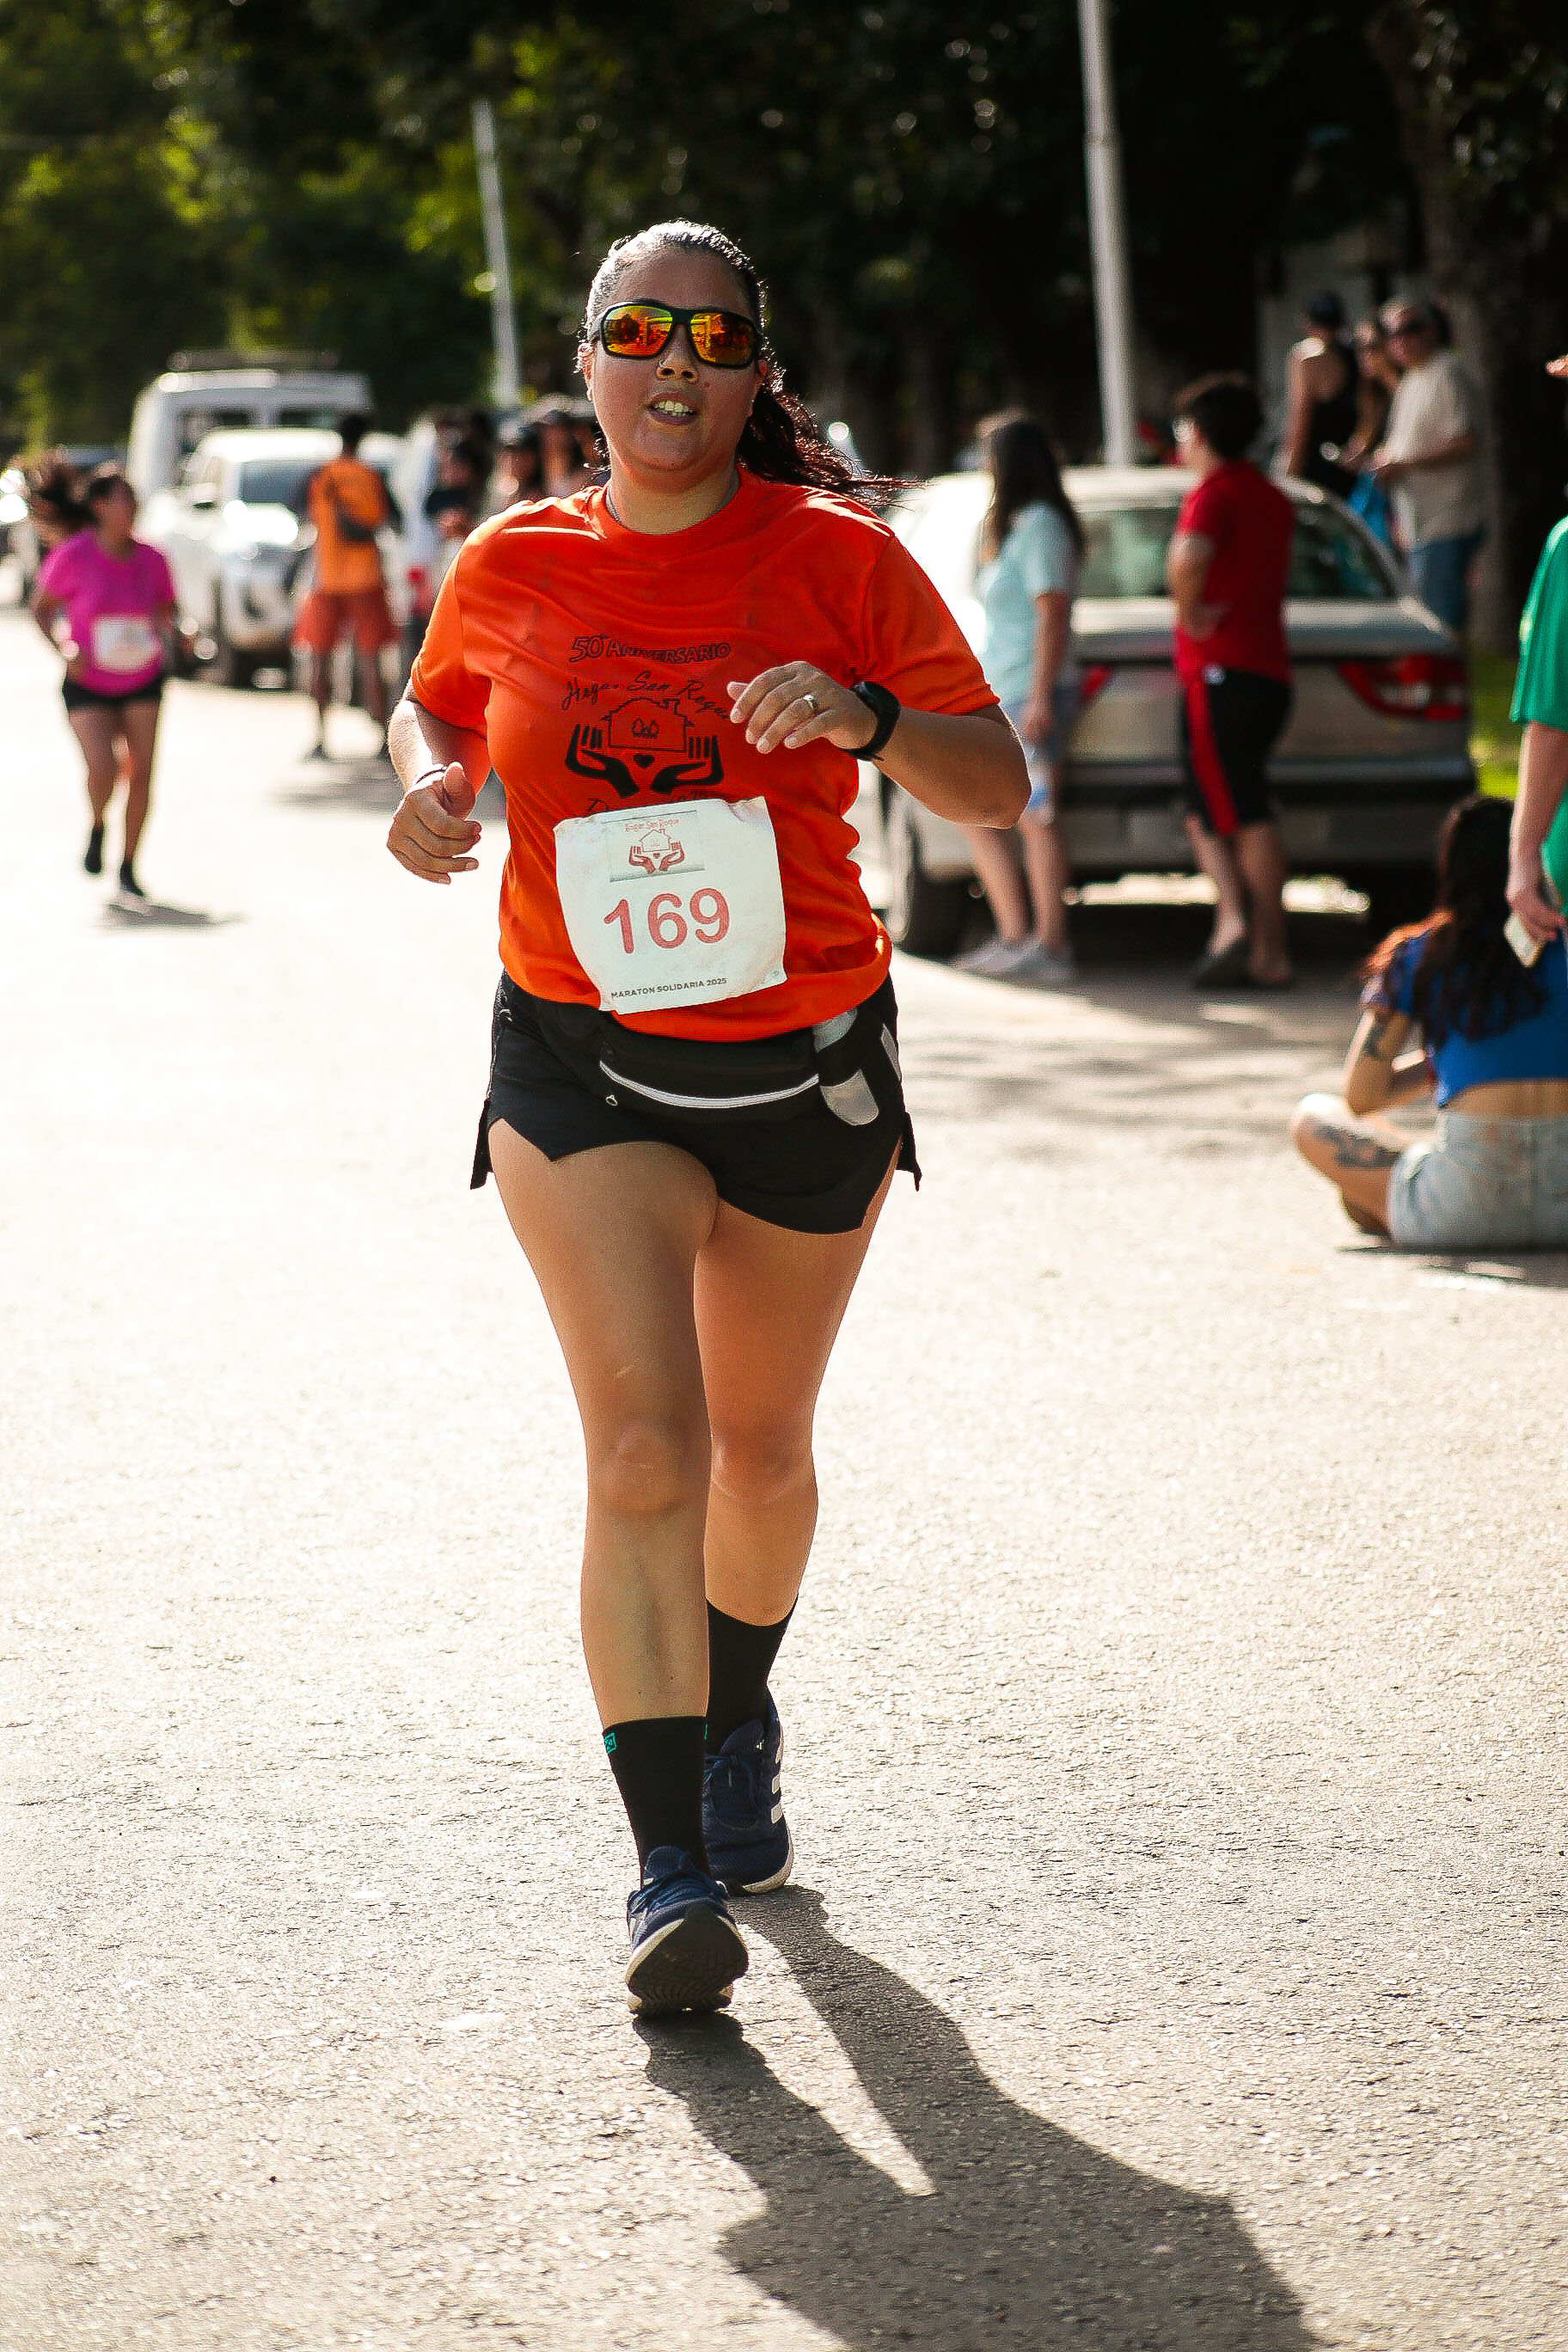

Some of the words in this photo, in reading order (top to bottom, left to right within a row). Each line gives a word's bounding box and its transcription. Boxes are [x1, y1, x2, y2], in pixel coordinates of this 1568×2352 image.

[603, 887, 730, 954] 169
[610, 987, 655, 999] MARATON
[657, 979, 705, 993] SOLIDARIA
[707, 977, 727, 987] 2025
